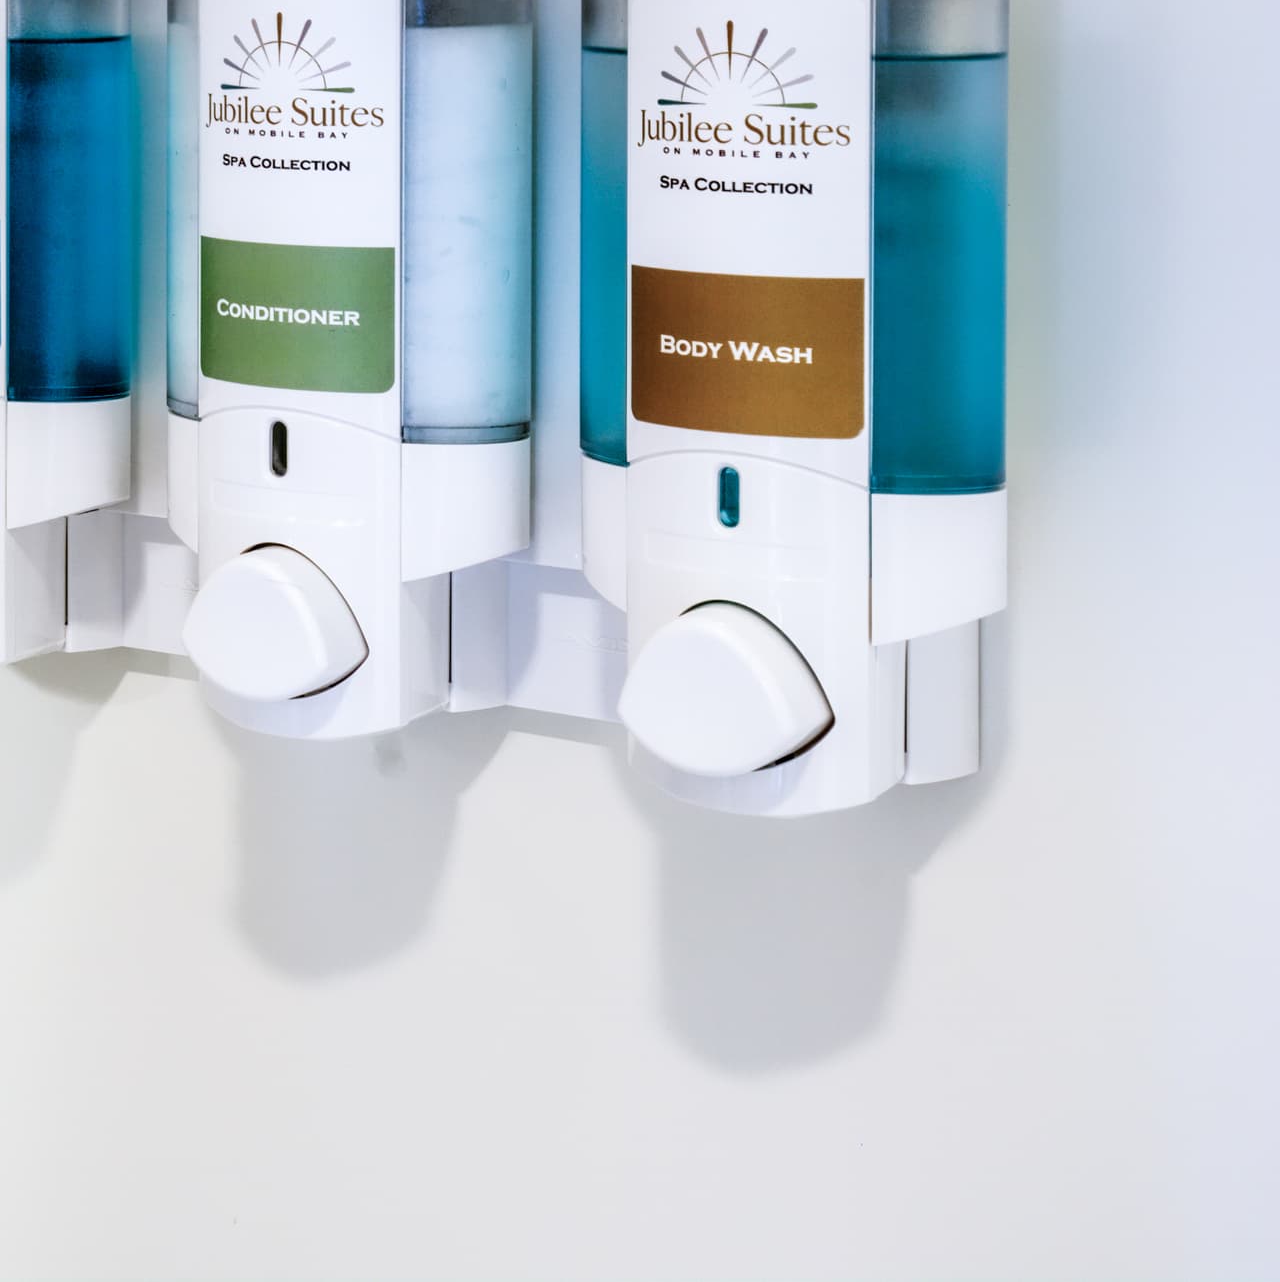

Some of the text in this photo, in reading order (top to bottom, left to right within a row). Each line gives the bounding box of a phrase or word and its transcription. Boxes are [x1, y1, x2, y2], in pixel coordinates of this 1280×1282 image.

[205, 93, 385, 128] Jubilee Suites
[225, 127, 349, 140] ON MOBILE BAY
[637, 109, 851, 148] Jubilee Suites
[663, 146, 811, 159] ON MOBILE BAY
